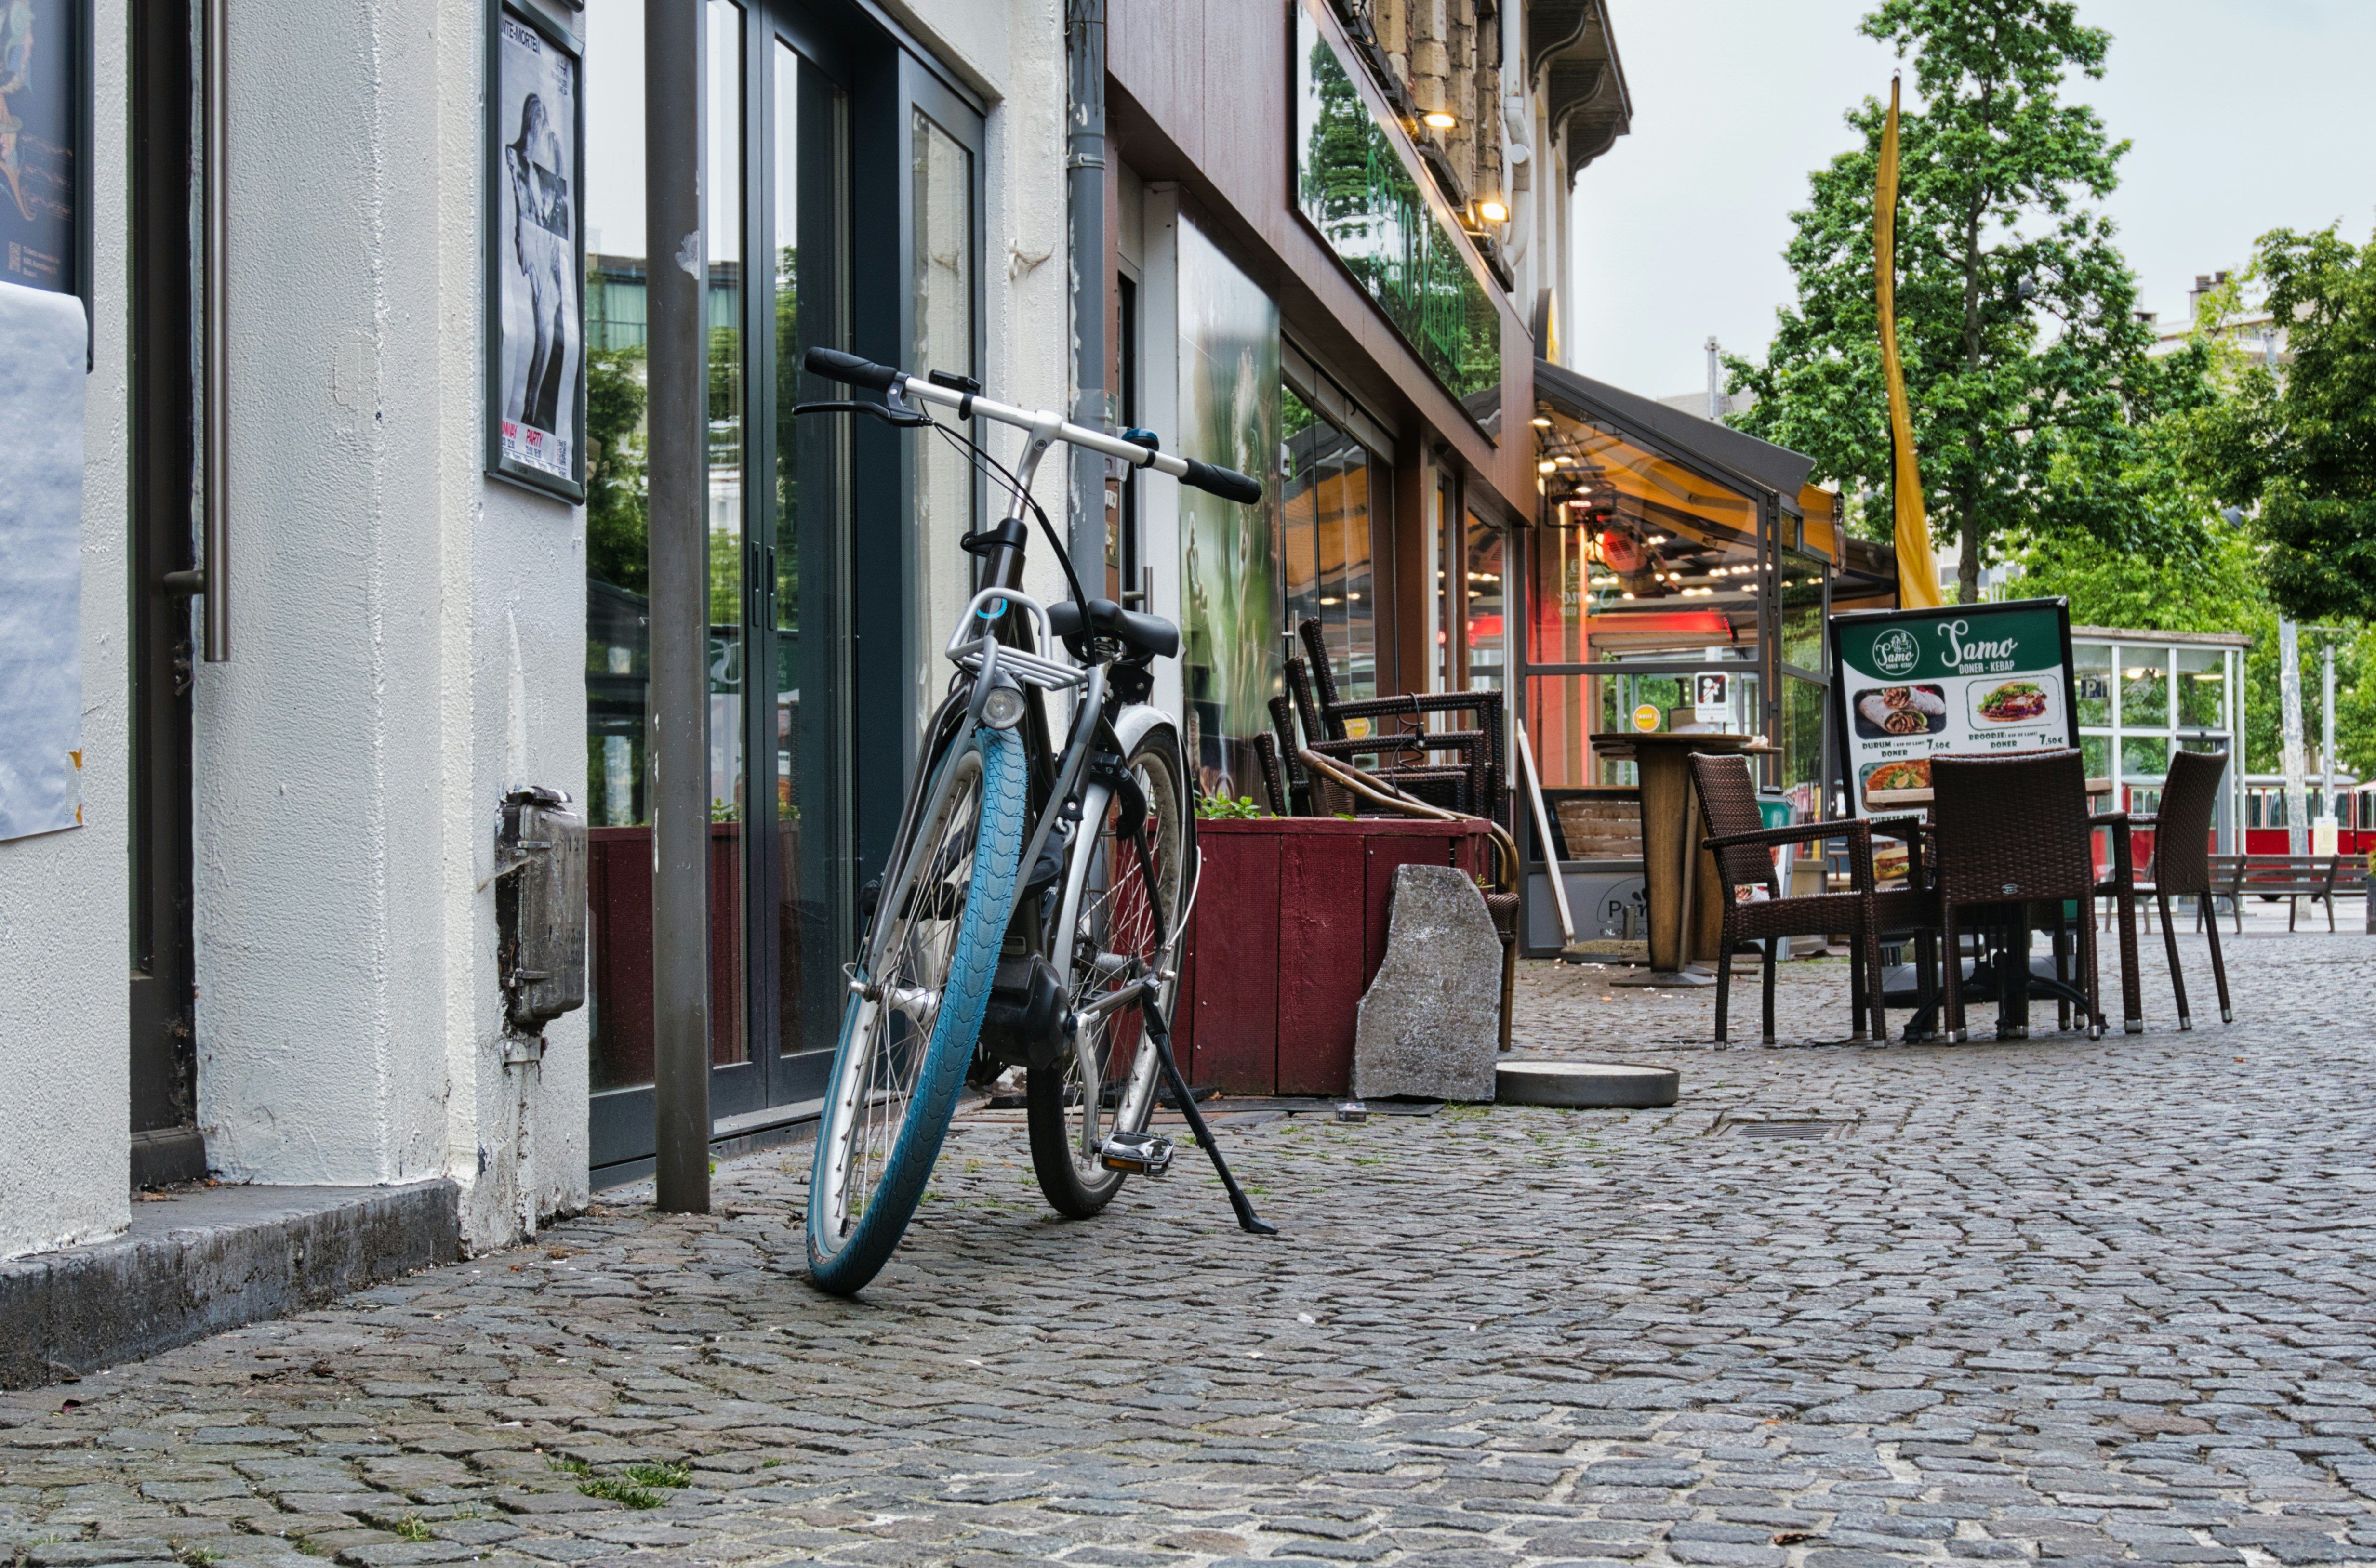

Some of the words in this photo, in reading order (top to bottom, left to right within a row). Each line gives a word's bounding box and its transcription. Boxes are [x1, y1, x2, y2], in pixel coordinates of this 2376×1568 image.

[526, 428, 544, 448] PARTY
[1938, 619, 2018, 667] Samo
[1876, 643, 1914, 666] Samo
[1959, 663, 1984, 674] DONER
[1990, 660, 2015, 672] KEBAP
[1862, 741, 1891, 750] DURUM
[1926, 738, 1950, 751] 7,50€
[2039, 734, 2063, 746] 7,50€
